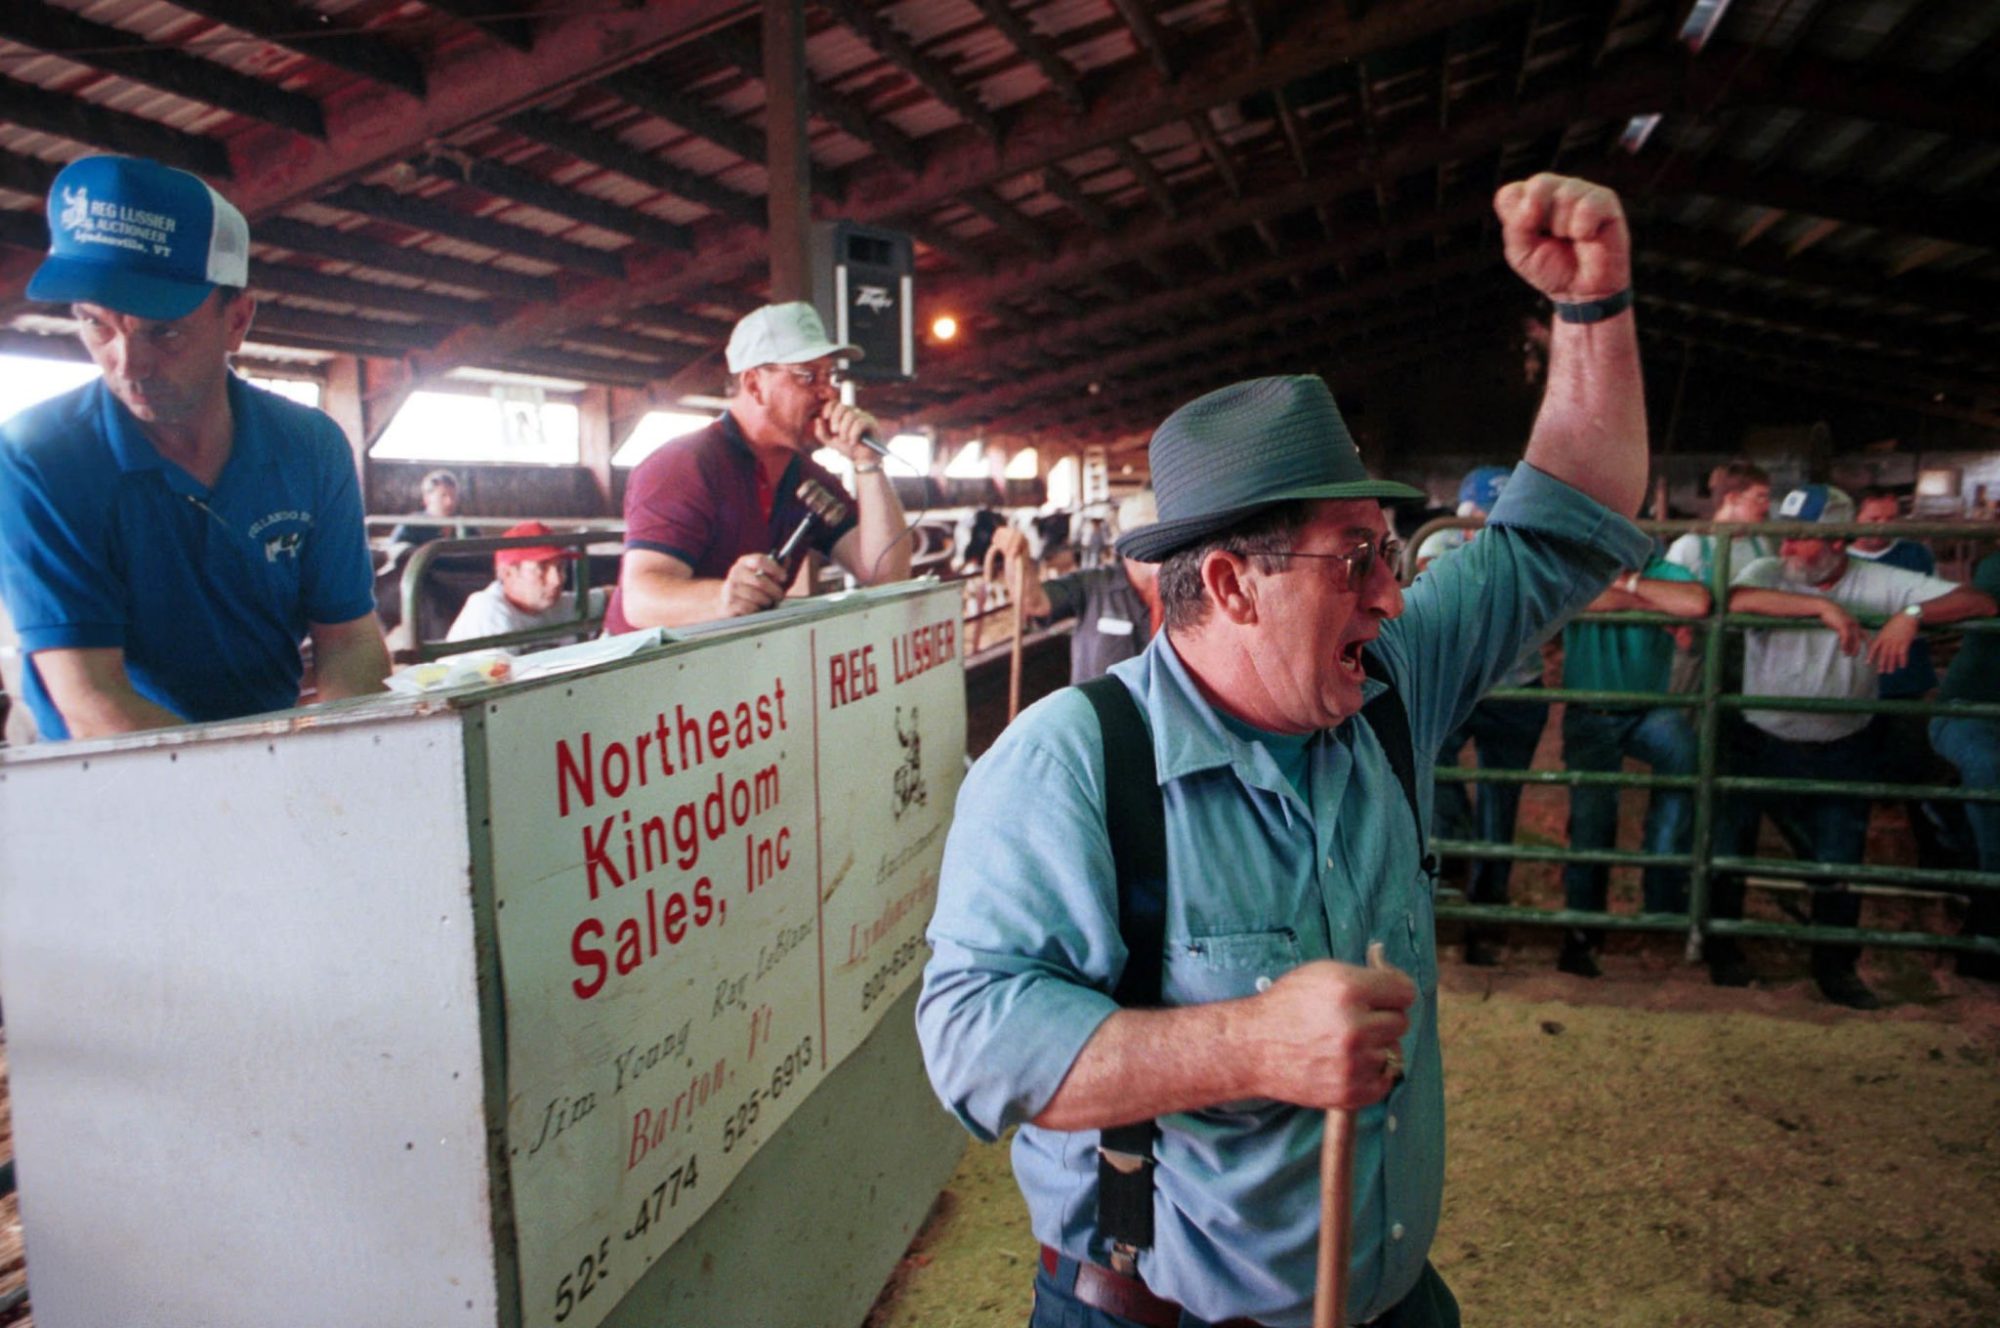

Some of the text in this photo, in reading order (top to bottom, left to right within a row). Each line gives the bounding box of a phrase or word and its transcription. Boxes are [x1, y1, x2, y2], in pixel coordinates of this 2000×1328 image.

[91, 200, 117, 219] REG
[829, 617, 956, 709] REG LUSSIER
[555, 677, 788, 817] Northeast
[582, 763, 780, 900] Kingdom
[570, 876, 728, 1001] Sales,
[746, 825, 792, 893] Inc
[528, 1018, 692, 1160] Jim Young
[723, 1035, 812, 1153] 525-6913
